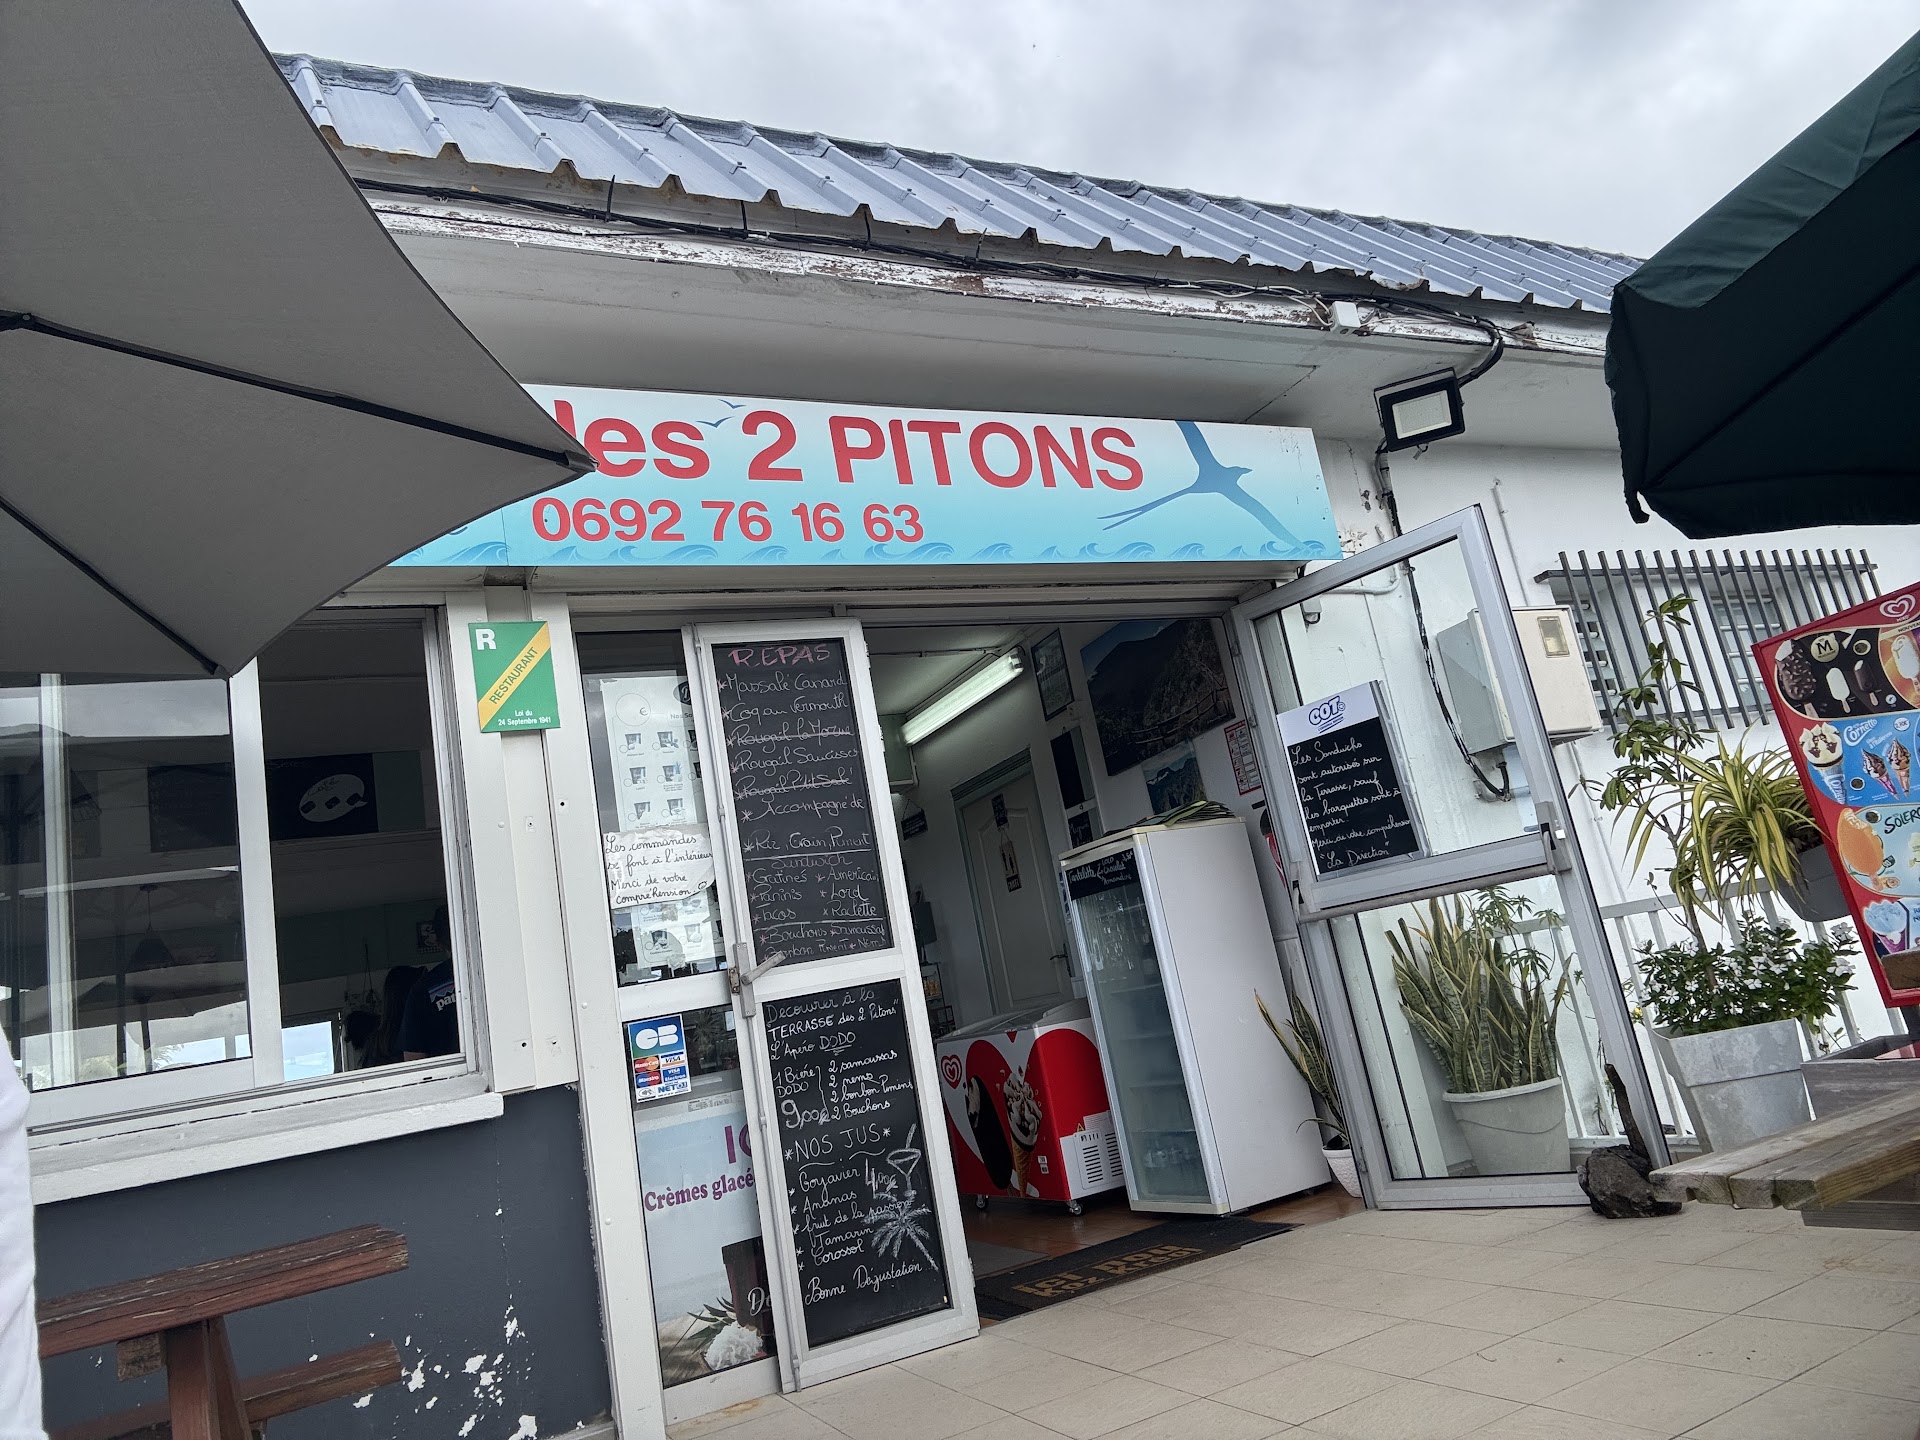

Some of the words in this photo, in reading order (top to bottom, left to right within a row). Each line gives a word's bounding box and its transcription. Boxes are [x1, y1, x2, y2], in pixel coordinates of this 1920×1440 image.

[747, 411, 803, 482] 2
[828, 415, 1144, 490] PITONS
[532, 498, 685, 542] 0692
[701, 500, 772, 542] 76
[791, 502, 845, 543] 16
[863, 503, 924, 544] 63
[475, 629, 497, 650] R
[728, 644, 830, 667] REPAS
[489, 647, 538, 704] RESTAURANT
[498, 718, 506, 726] 24
[507, 717, 537, 727] Septembre
[539, 716, 551, 724] 1941
[514, 709, 524, 717] Loi
[525, 709, 533, 717] du
[735, 750, 793, 776] Rougail
[1291, 745, 1312, 766] Les
[1297, 770, 1318, 784] sont
[1301, 787, 1314, 802] la
[605, 835, 626, 854] Les
[629, 834, 697, 852] commandes
[607, 861, 620, 869] se
[625, 854, 649, 877] font
[652, 856, 662, 865] à
[611, 878, 641, 891] Merci
[645, 874, 659, 886] de
[663, 872, 688, 882] votre
[826, 900, 877, 917] Raclette
[838, 1012, 855, 1025] des
[858, 1007, 866, 1021] 2
[635, 1024, 679, 1050] CB
[820, 1031, 857, 1050] DODO
[828, 1060, 838, 1073] 2
[775, 1081, 809, 1098] DODO
[829, 1075, 838, 1088] 2
[830, 1090, 839, 1103] 2
[831, 1105, 841, 1120] 2
[843, 1097, 890, 1118] Bouchons
[644, 1186, 709, 1212] Crèmes
[803, 1195, 857, 1220] Ananas
[834, 1210, 849, 1225] de
[851, 1201, 865, 1219] la
[805, 1276, 846, 1306] Bonne
[853, 1261, 922, 1293] Dégustation
